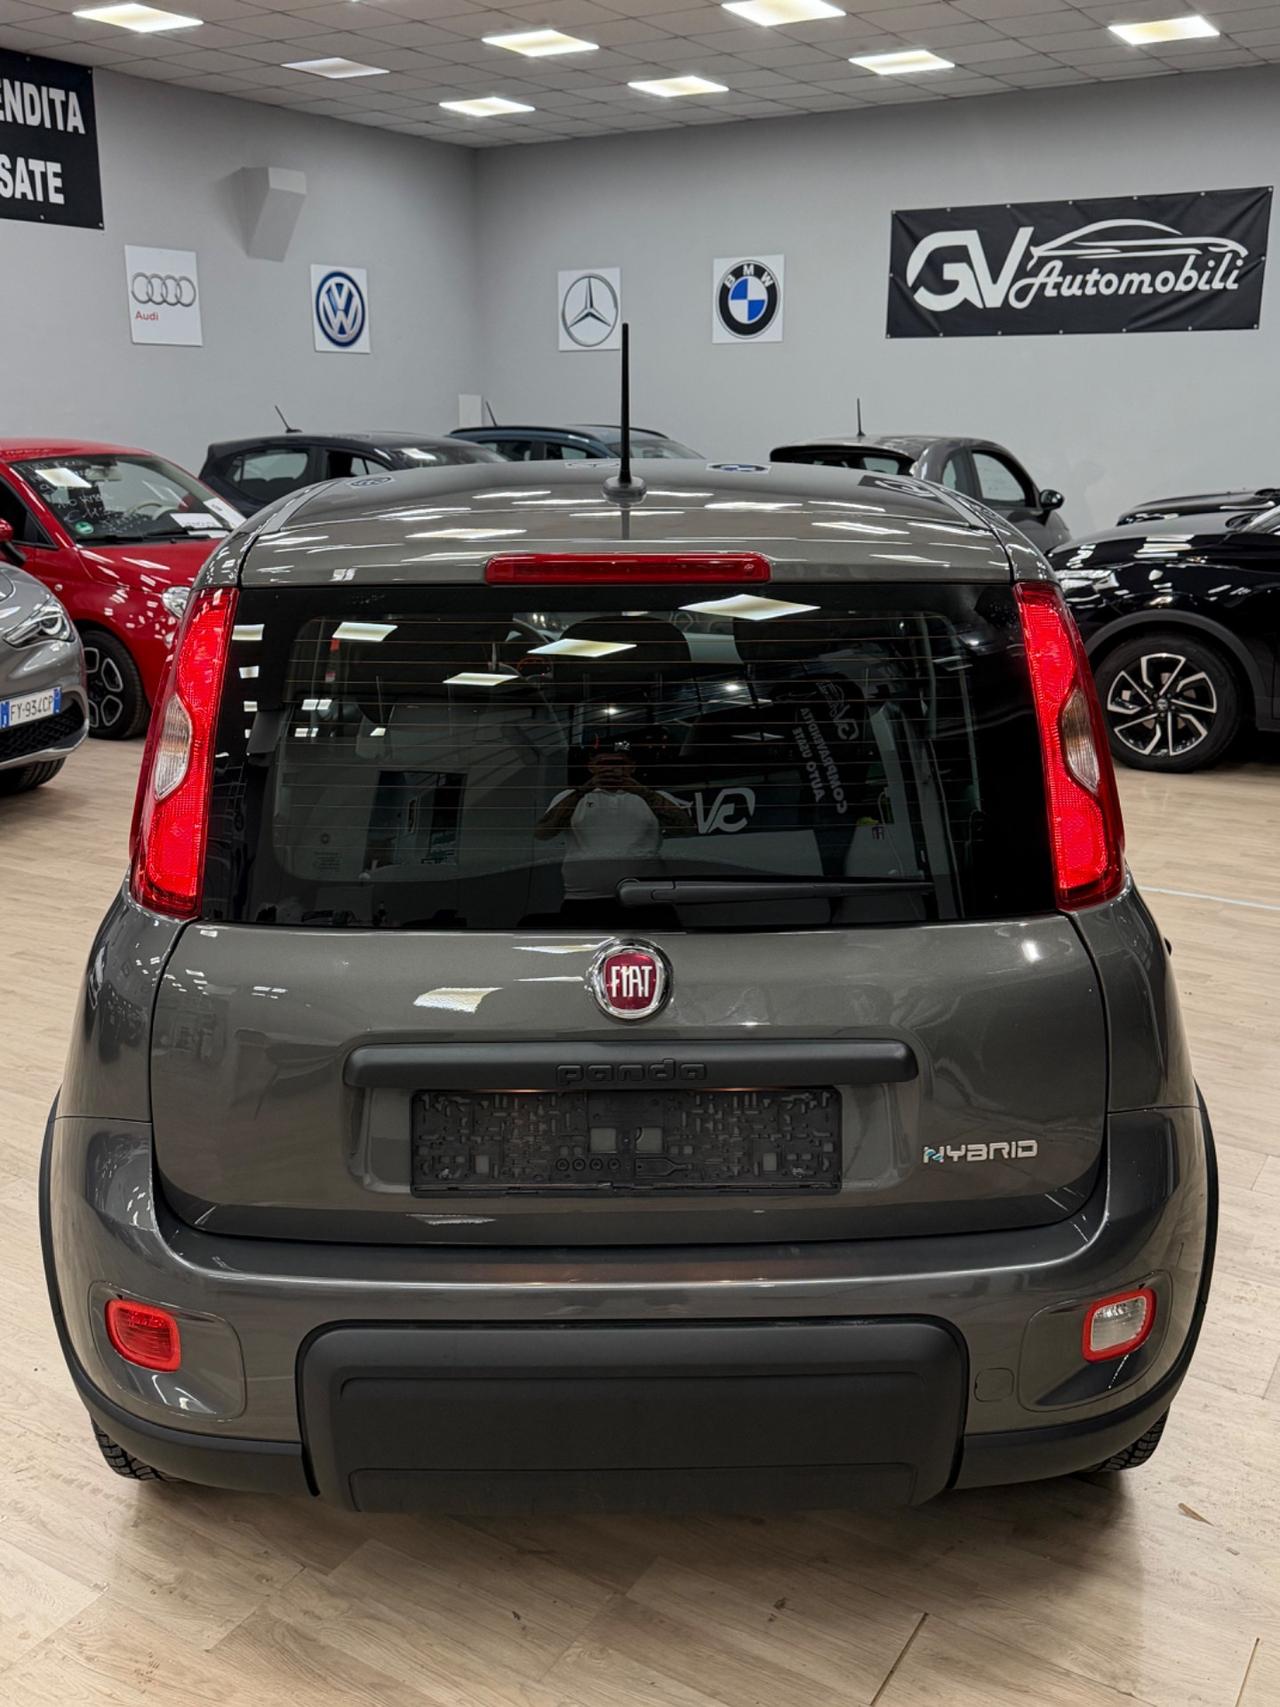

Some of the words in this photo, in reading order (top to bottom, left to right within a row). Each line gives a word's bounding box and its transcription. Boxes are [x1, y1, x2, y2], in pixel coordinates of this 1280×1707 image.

[725, 263, 774, 288] BMW
[1008, 252, 1243, 309] Automobili
[135, 310, 159, 321] Audi
[611, 965, 652, 998] FIAT
[556, 1057, 707, 1086] panda
[923, 1139, 1038, 1163] HYBRID
